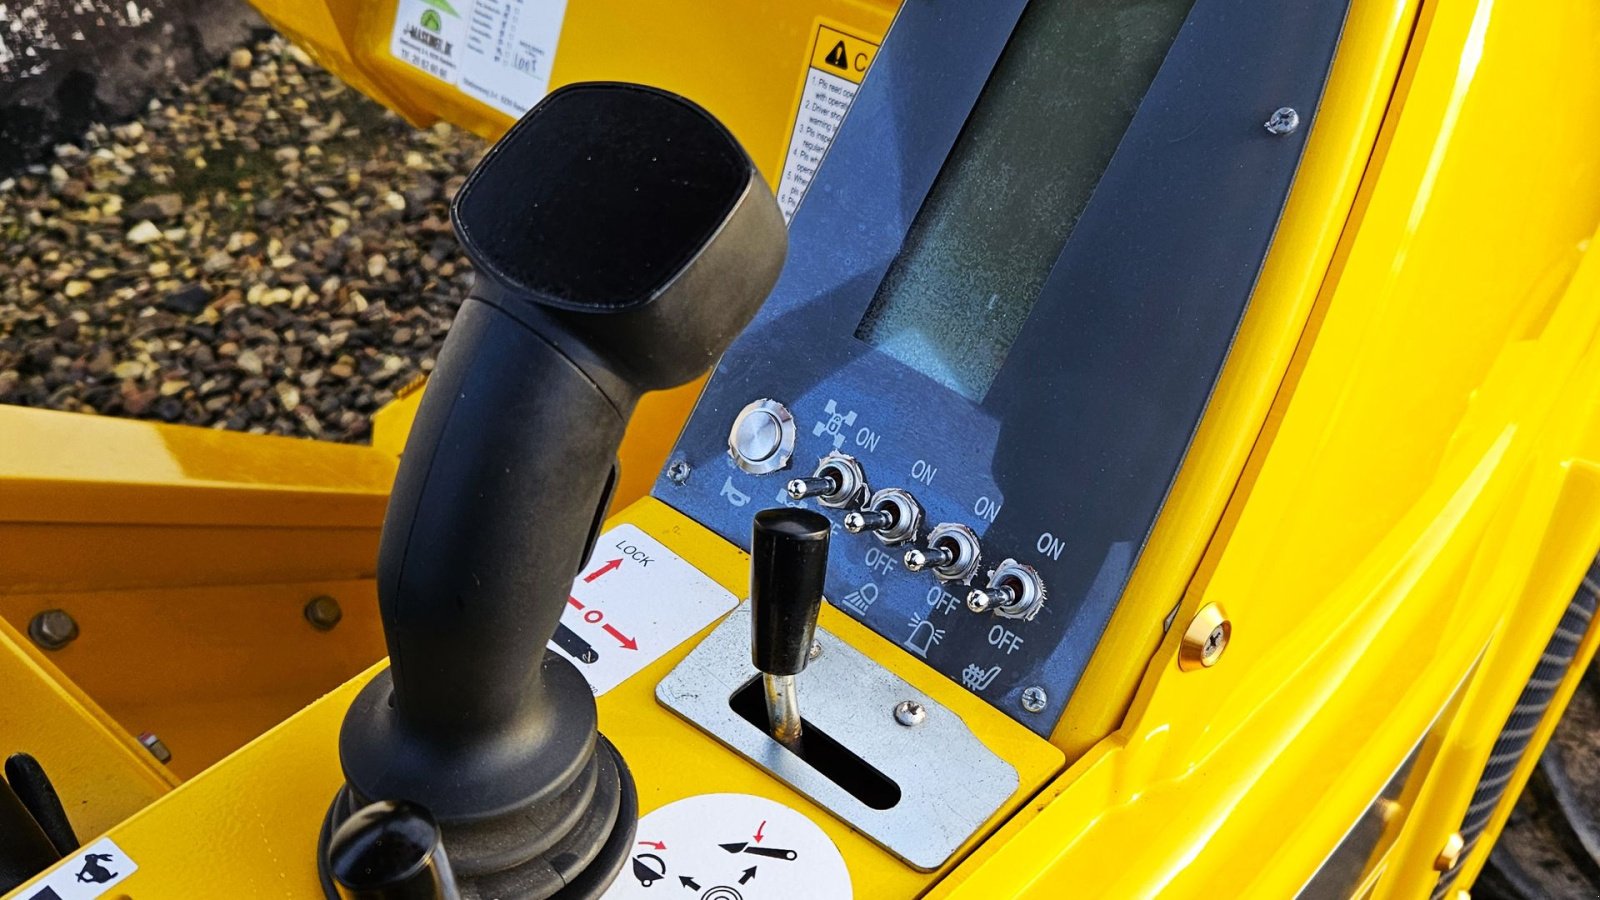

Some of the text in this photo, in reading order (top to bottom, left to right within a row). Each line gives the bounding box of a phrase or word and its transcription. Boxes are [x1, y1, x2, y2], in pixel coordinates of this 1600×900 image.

[829, 84, 842, 95] read
[811, 102, 830, 116] Driver
[809, 117, 832, 132] warning
[855, 427, 881, 453] ON
[911, 459, 937, 486] ON
[974, 496, 1001, 523] ON
[615, 540, 655, 567] LOCK
[1036, 532, 1066, 561] ON
[865, 546, 898, 576] OFF
[926, 586, 961, 615] OFF
[988, 624, 1024, 655] OFF
